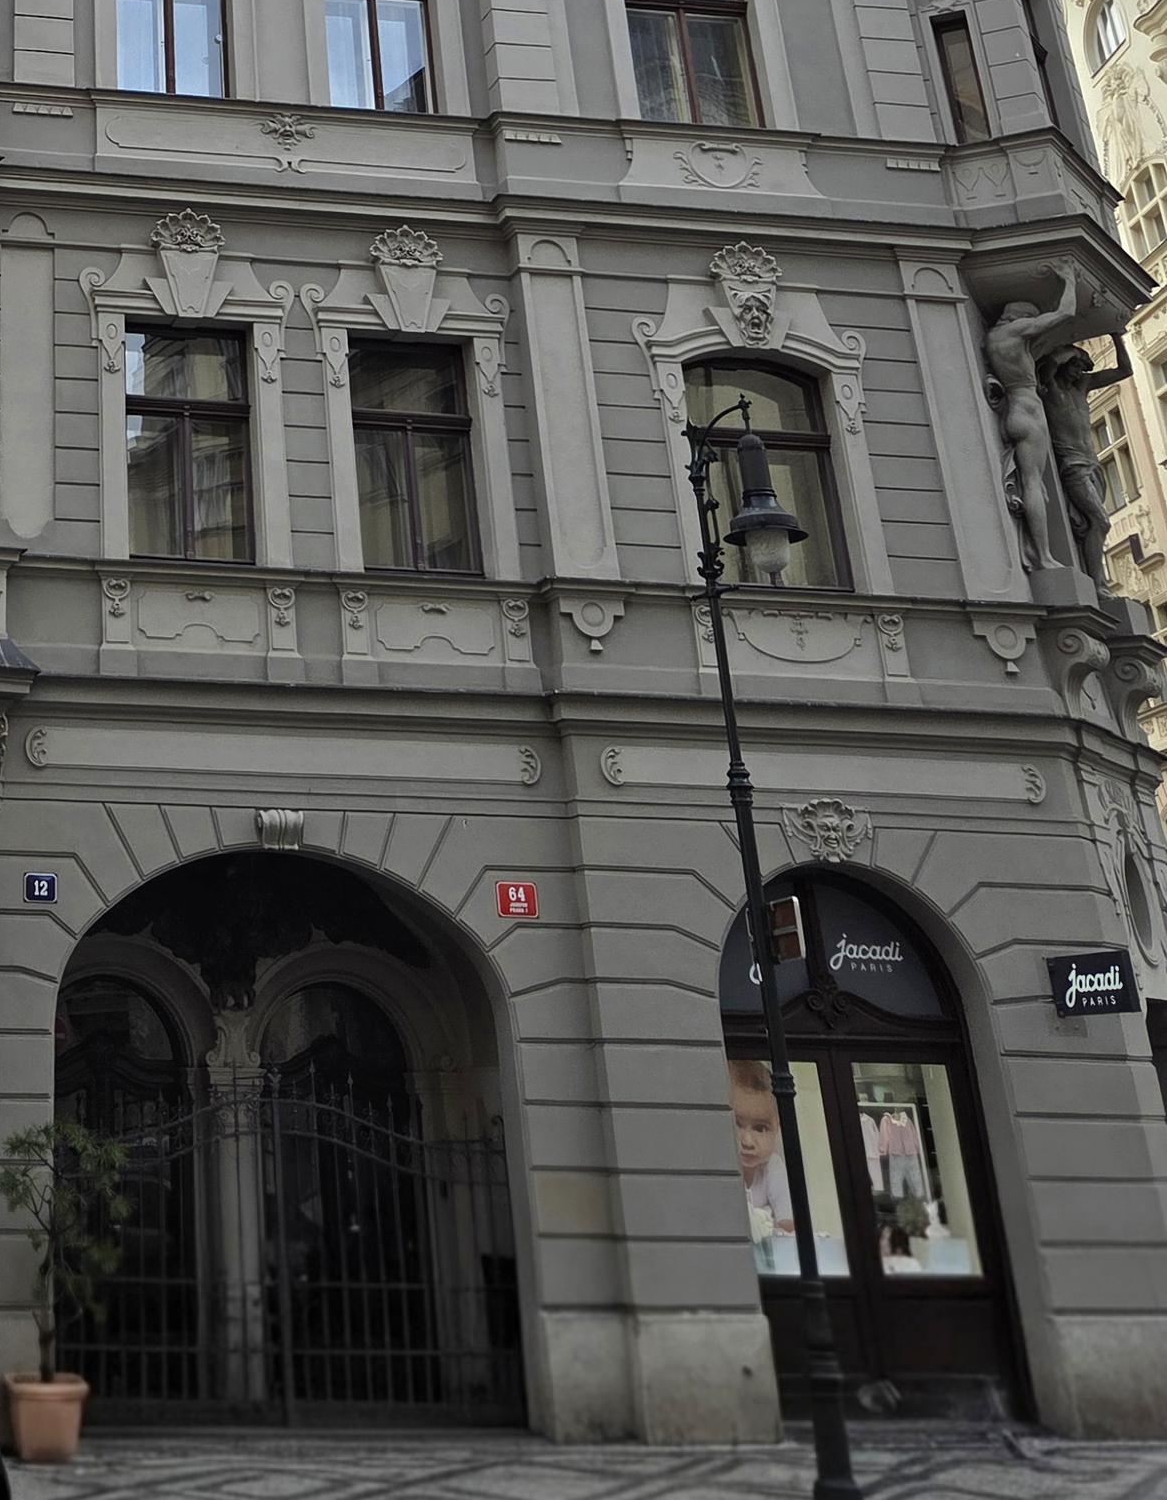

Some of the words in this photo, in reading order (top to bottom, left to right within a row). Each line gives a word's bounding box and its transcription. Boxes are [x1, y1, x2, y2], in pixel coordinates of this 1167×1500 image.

[34, 879, 49, 896] 12
[508, 886, 526, 902] 64
[829, 932, 904, 971] jacadi
[850, 961, 893, 973] PARIS
[1065, 963, 1124, 1008] jacadi
[1081, 995, 1117, 1008] PARIS
